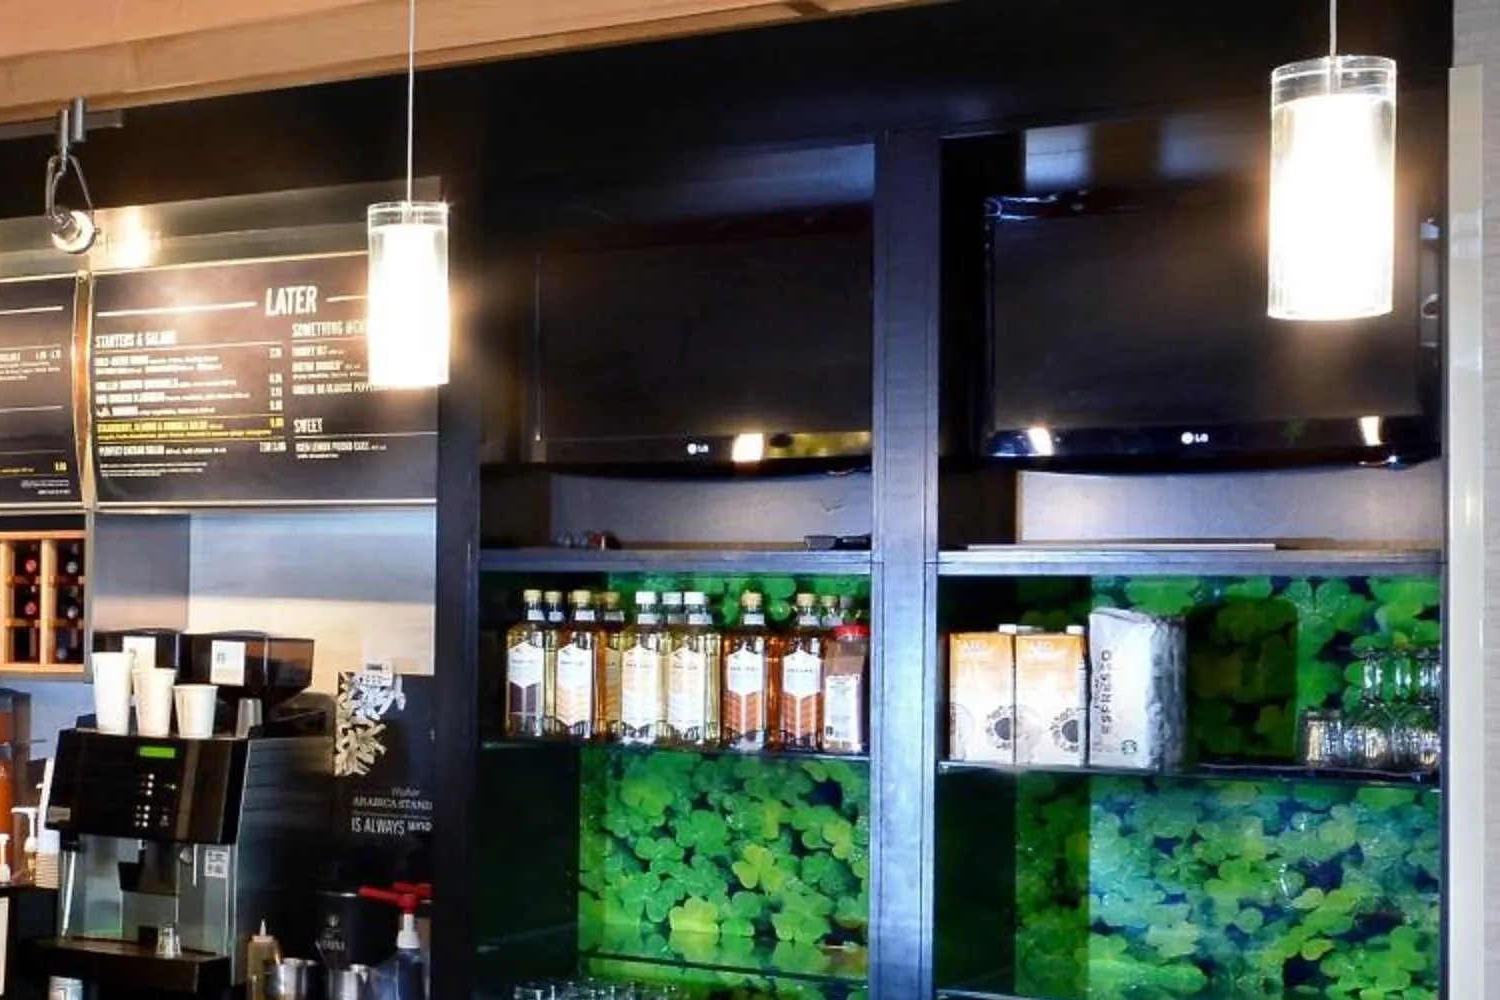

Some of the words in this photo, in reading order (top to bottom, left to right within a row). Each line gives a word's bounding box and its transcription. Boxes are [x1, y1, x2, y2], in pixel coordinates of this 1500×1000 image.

[265, 285, 318, 317] LATER
[293, 417, 323, 433] SWEET
[351, 816, 362, 833] IS
[364, 817, 405, 836] ALWAYS
